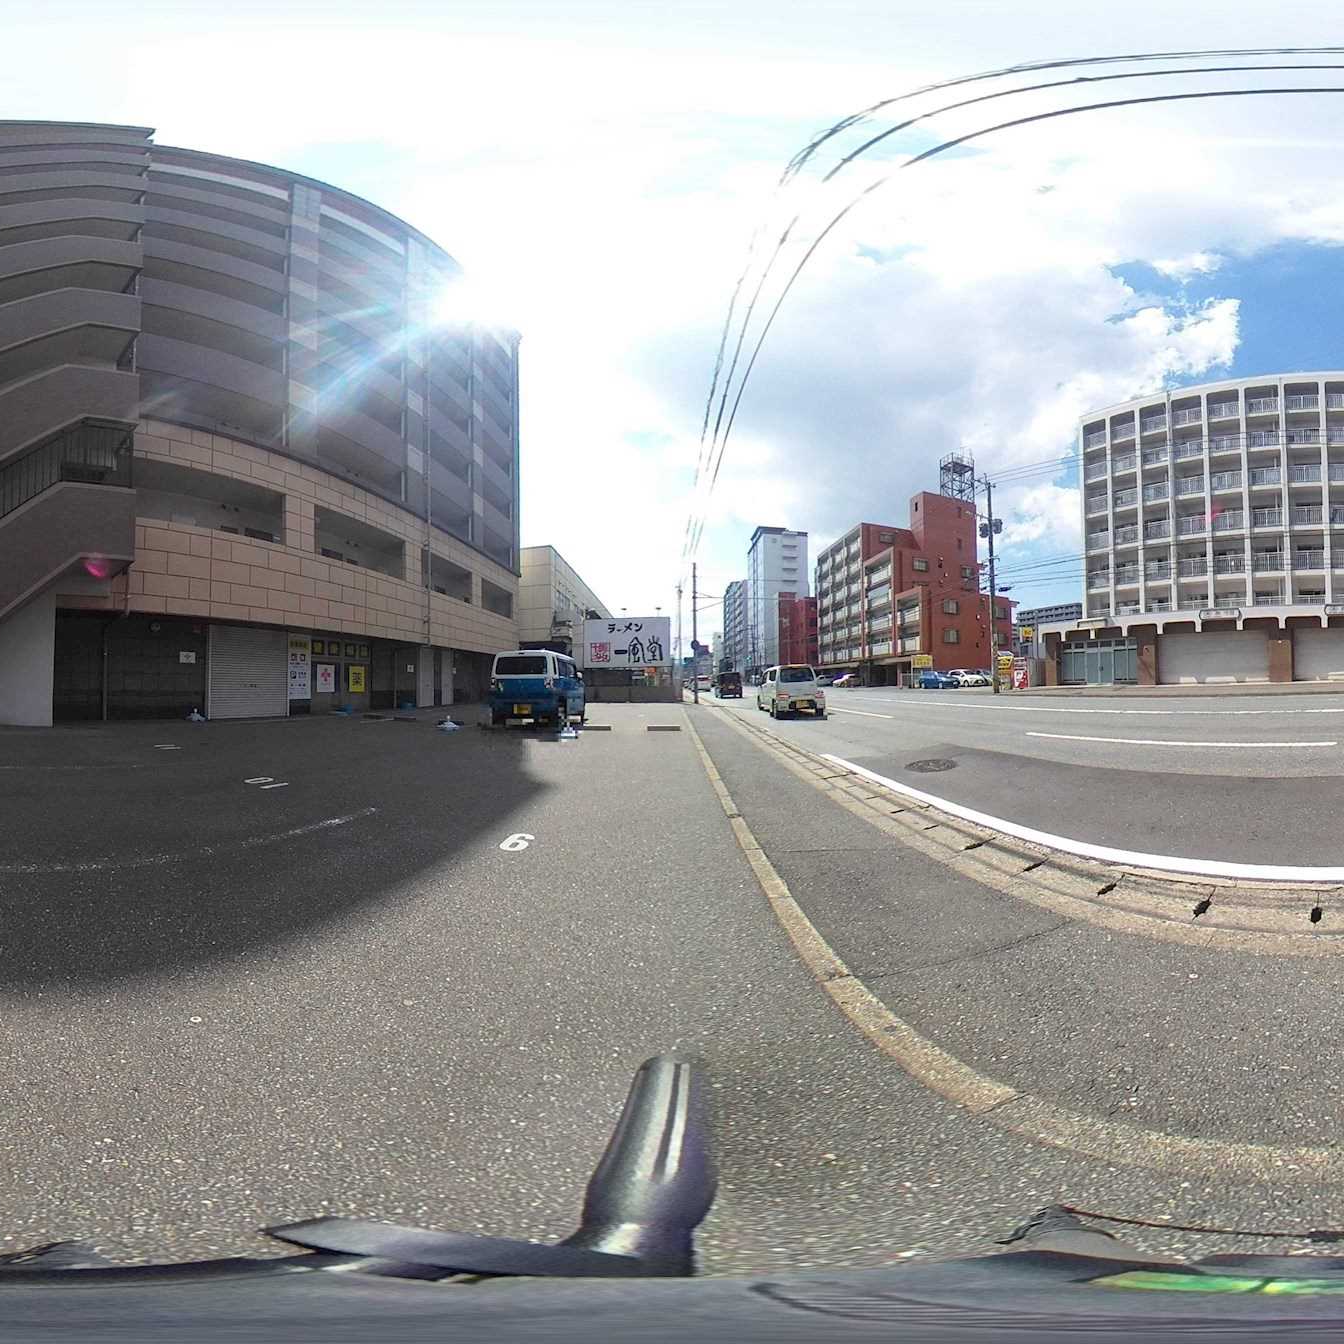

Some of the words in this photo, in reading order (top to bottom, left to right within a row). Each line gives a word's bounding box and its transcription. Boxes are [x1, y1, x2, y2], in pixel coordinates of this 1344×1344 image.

[607, 622, 643, 633] ラーメン
[614, 635, 663, 664] 一風堂
